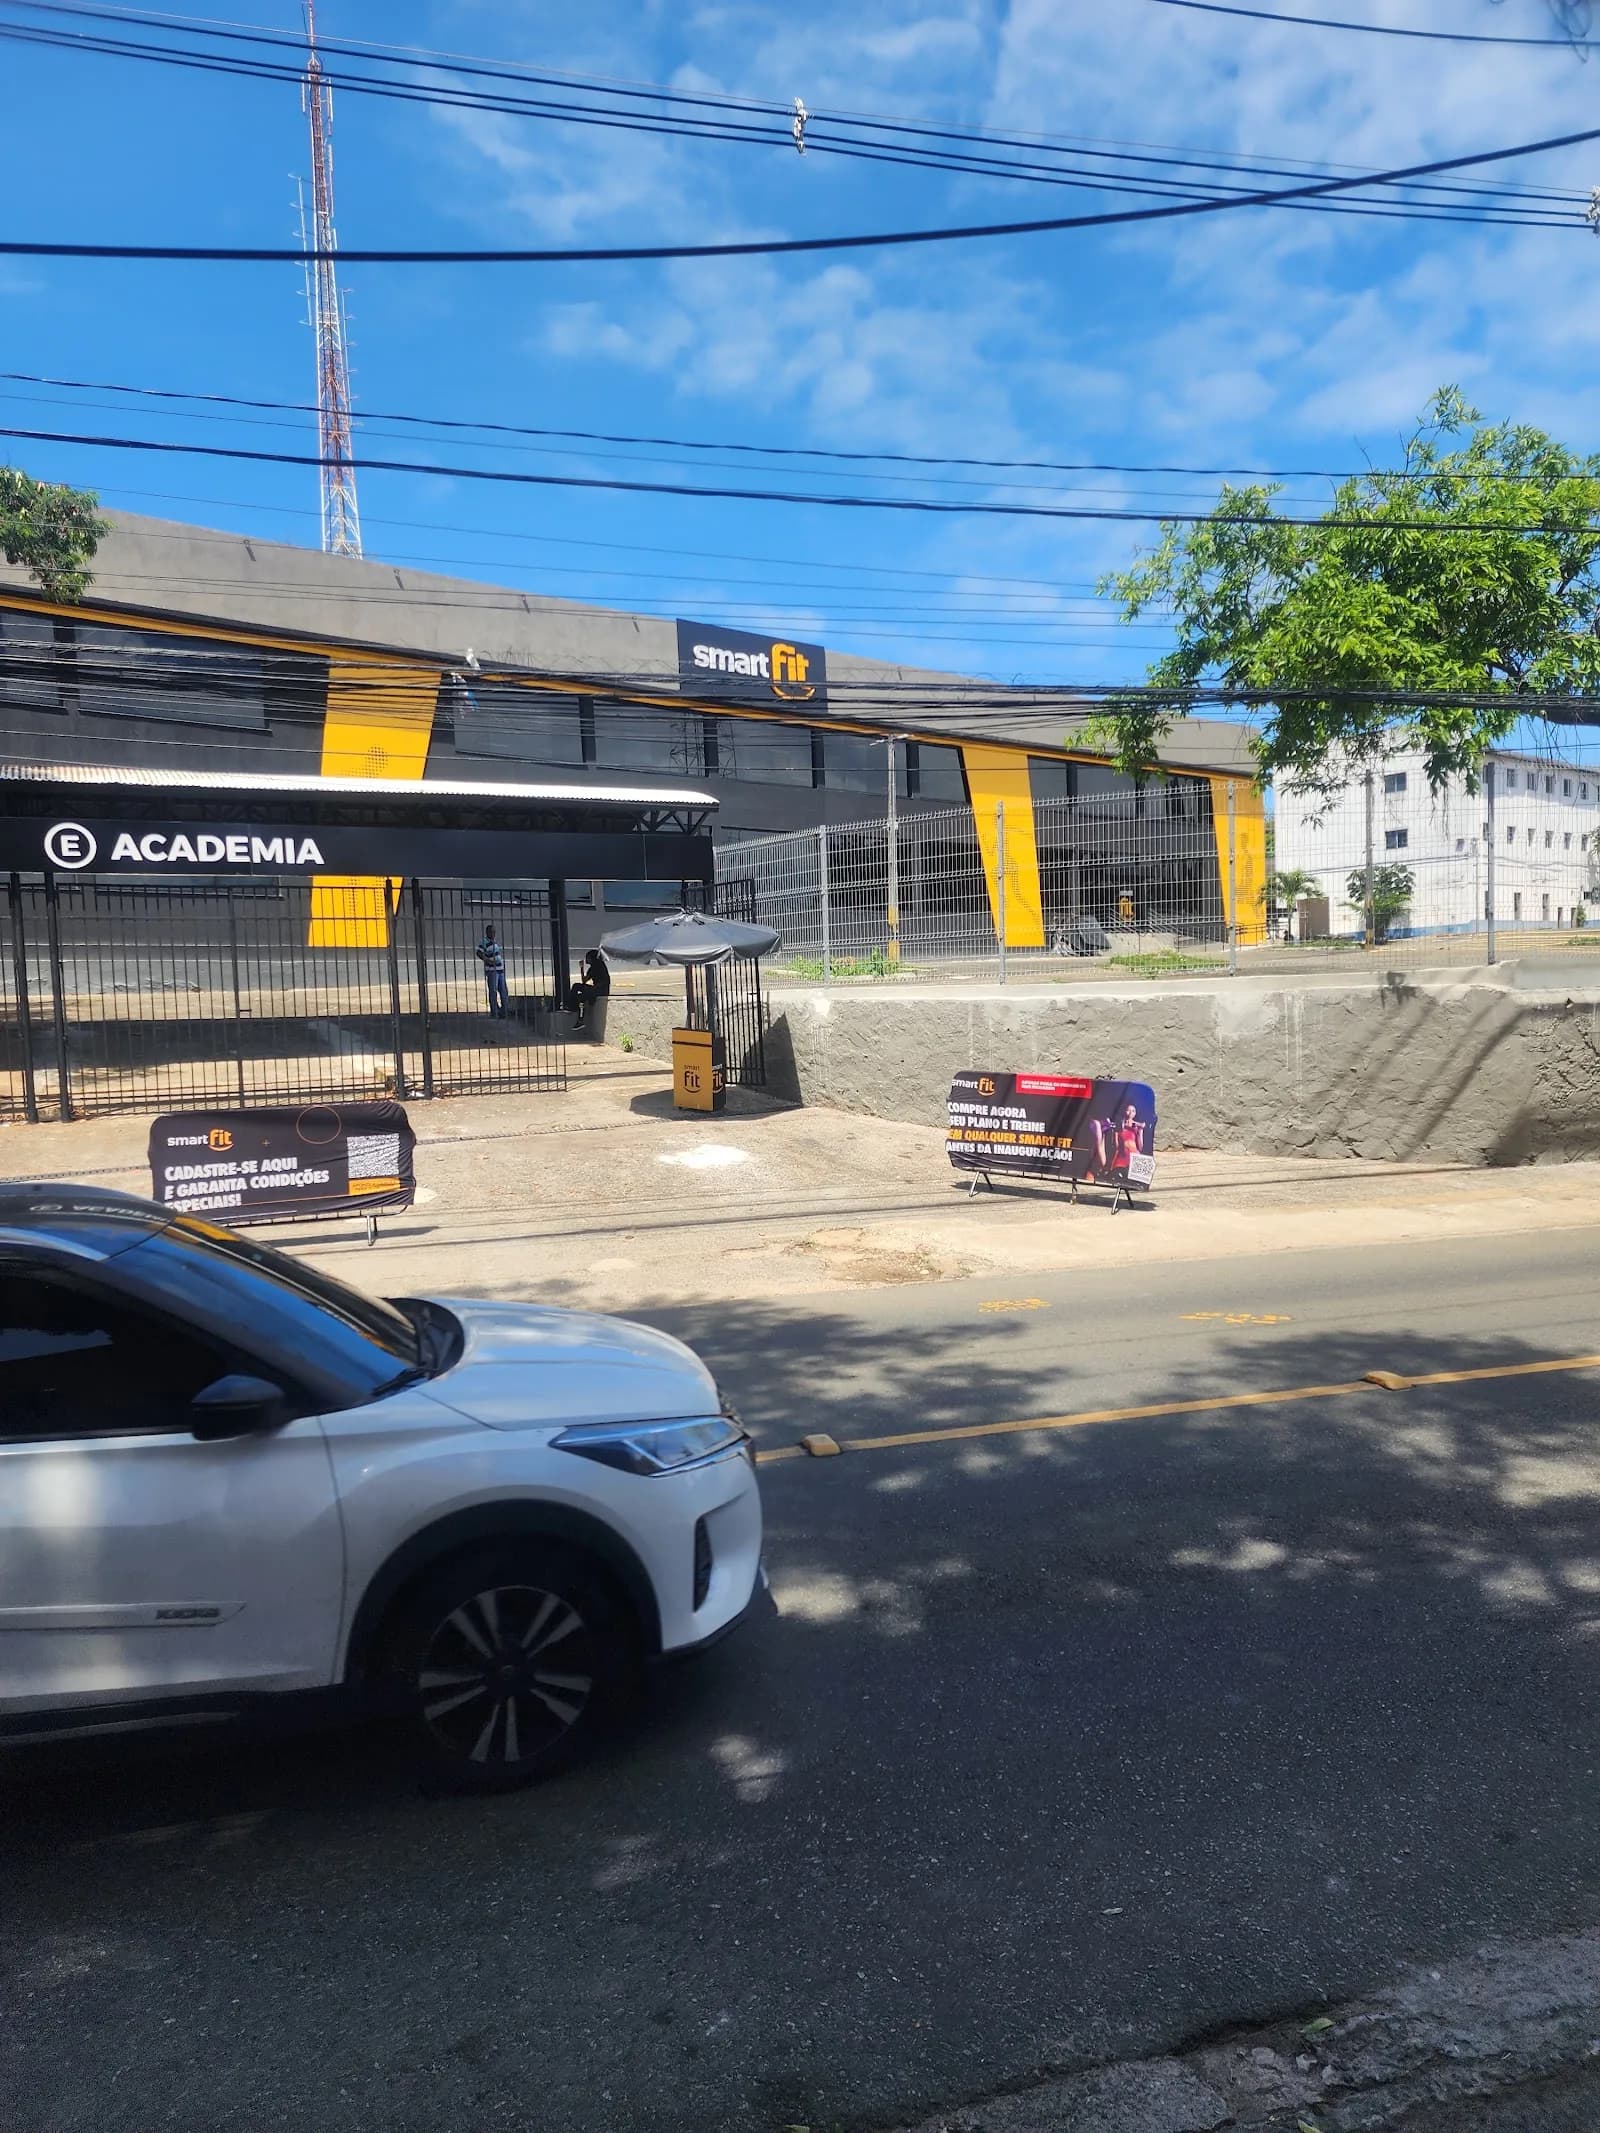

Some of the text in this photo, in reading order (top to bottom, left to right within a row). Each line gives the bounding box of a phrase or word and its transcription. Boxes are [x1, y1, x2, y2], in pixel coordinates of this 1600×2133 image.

[693, 643, 810, 683] smart fit
[60, 833, 325, 865] E ACADEMIA
[684, 1071, 700, 1088] fit
[952, 1077, 995, 1092] smart fit
[948, 1102, 1027, 1119] COMPRE AGORA
[949, 1115, 1046, 1133] SEU PLANO E TREINE
[167, 1128, 234, 1147] smart fit
[949, 1128, 1073, 1149] EM QUALQUER SMART FIT
[946, 1141, 1073, 1162] ANTES DA INAUGURAÇÃO!
[164, 1157, 298, 1181] CADASTRE-SE AQUI
[164, 1185, 175, 1200] E
[176, 1178, 248, 1198] GARANTA
[250, 1168, 330, 1189] CONDIÇÕES
